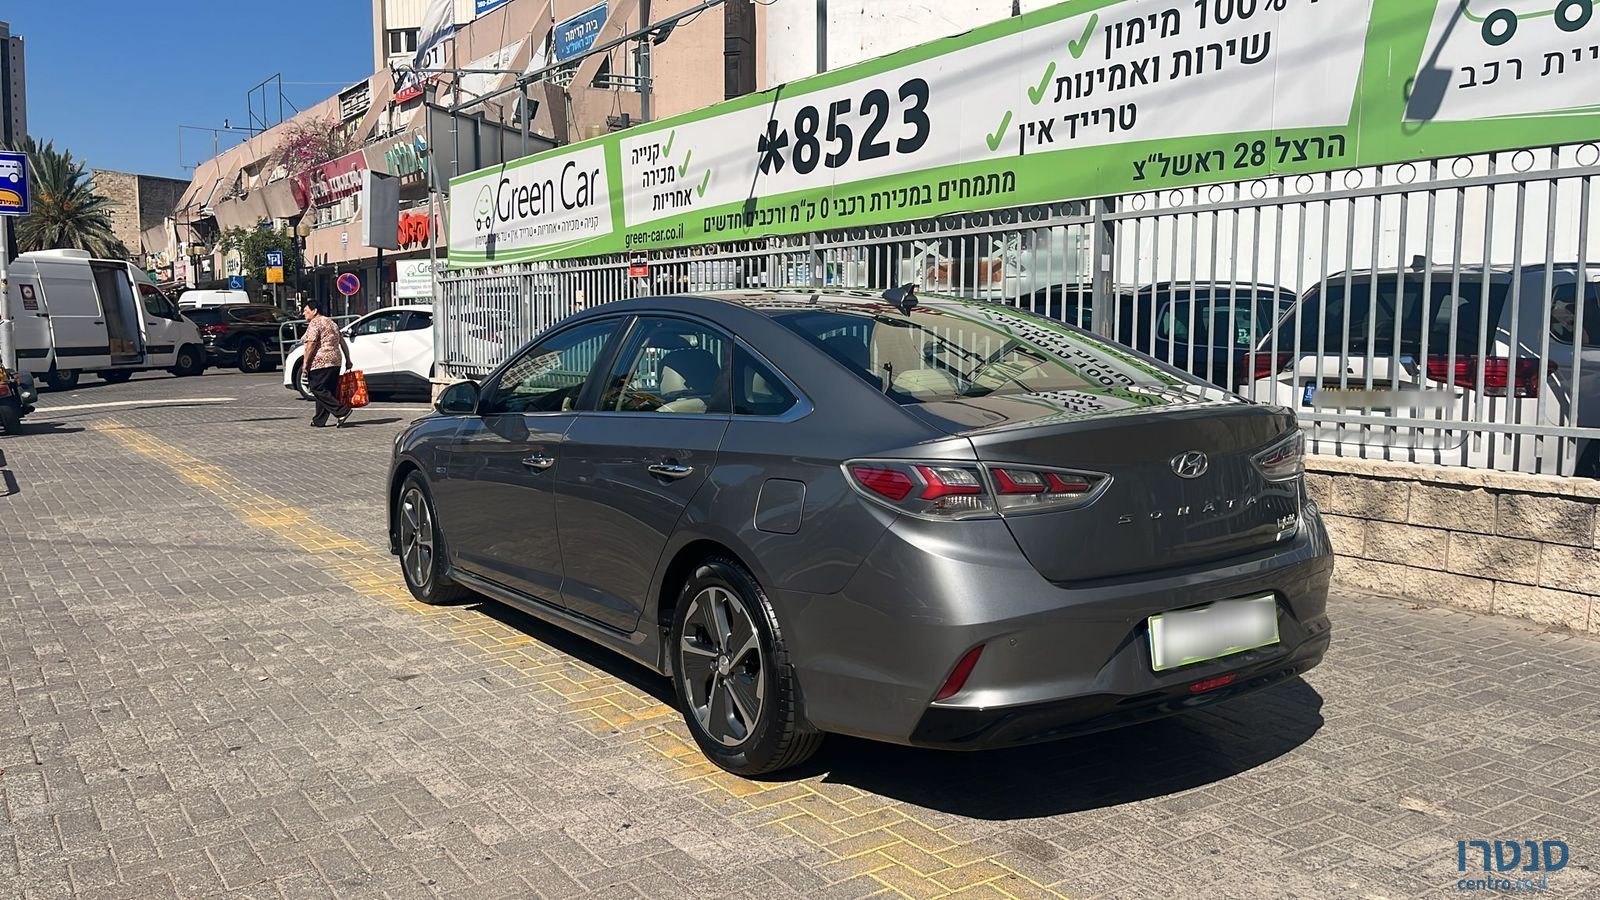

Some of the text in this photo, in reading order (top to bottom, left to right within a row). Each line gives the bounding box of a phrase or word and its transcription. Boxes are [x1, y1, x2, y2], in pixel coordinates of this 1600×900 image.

[1104, 9, 1181, 60] מימון
[1053, 30, 1272, 103] שירות ואמינות
[1458, 58, 1523, 89] רכב
[1018, 102, 1137, 156] טרייד אין
[631, 142, 660, 166] קנייה
[1233, 140, 1266, 170] 28
[1274, 133, 1346, 164] הרצל
[496, 160, 600, 223] Green Car
[642, 166, 675, 188] מכירה
[938, 170, 1016, 203] מתמחים
[652, 187, 692, 212] אחריות
[820, 199, 829, 219] 0
[833, 195, 865, 218] רכבי
[869, 183, 933, 211] במכירת
[625, 225, 684, 248] green-car.co.il
[703, 213, 743, 233] חדשים
[1117, 496, 1258, 525] SONATA
